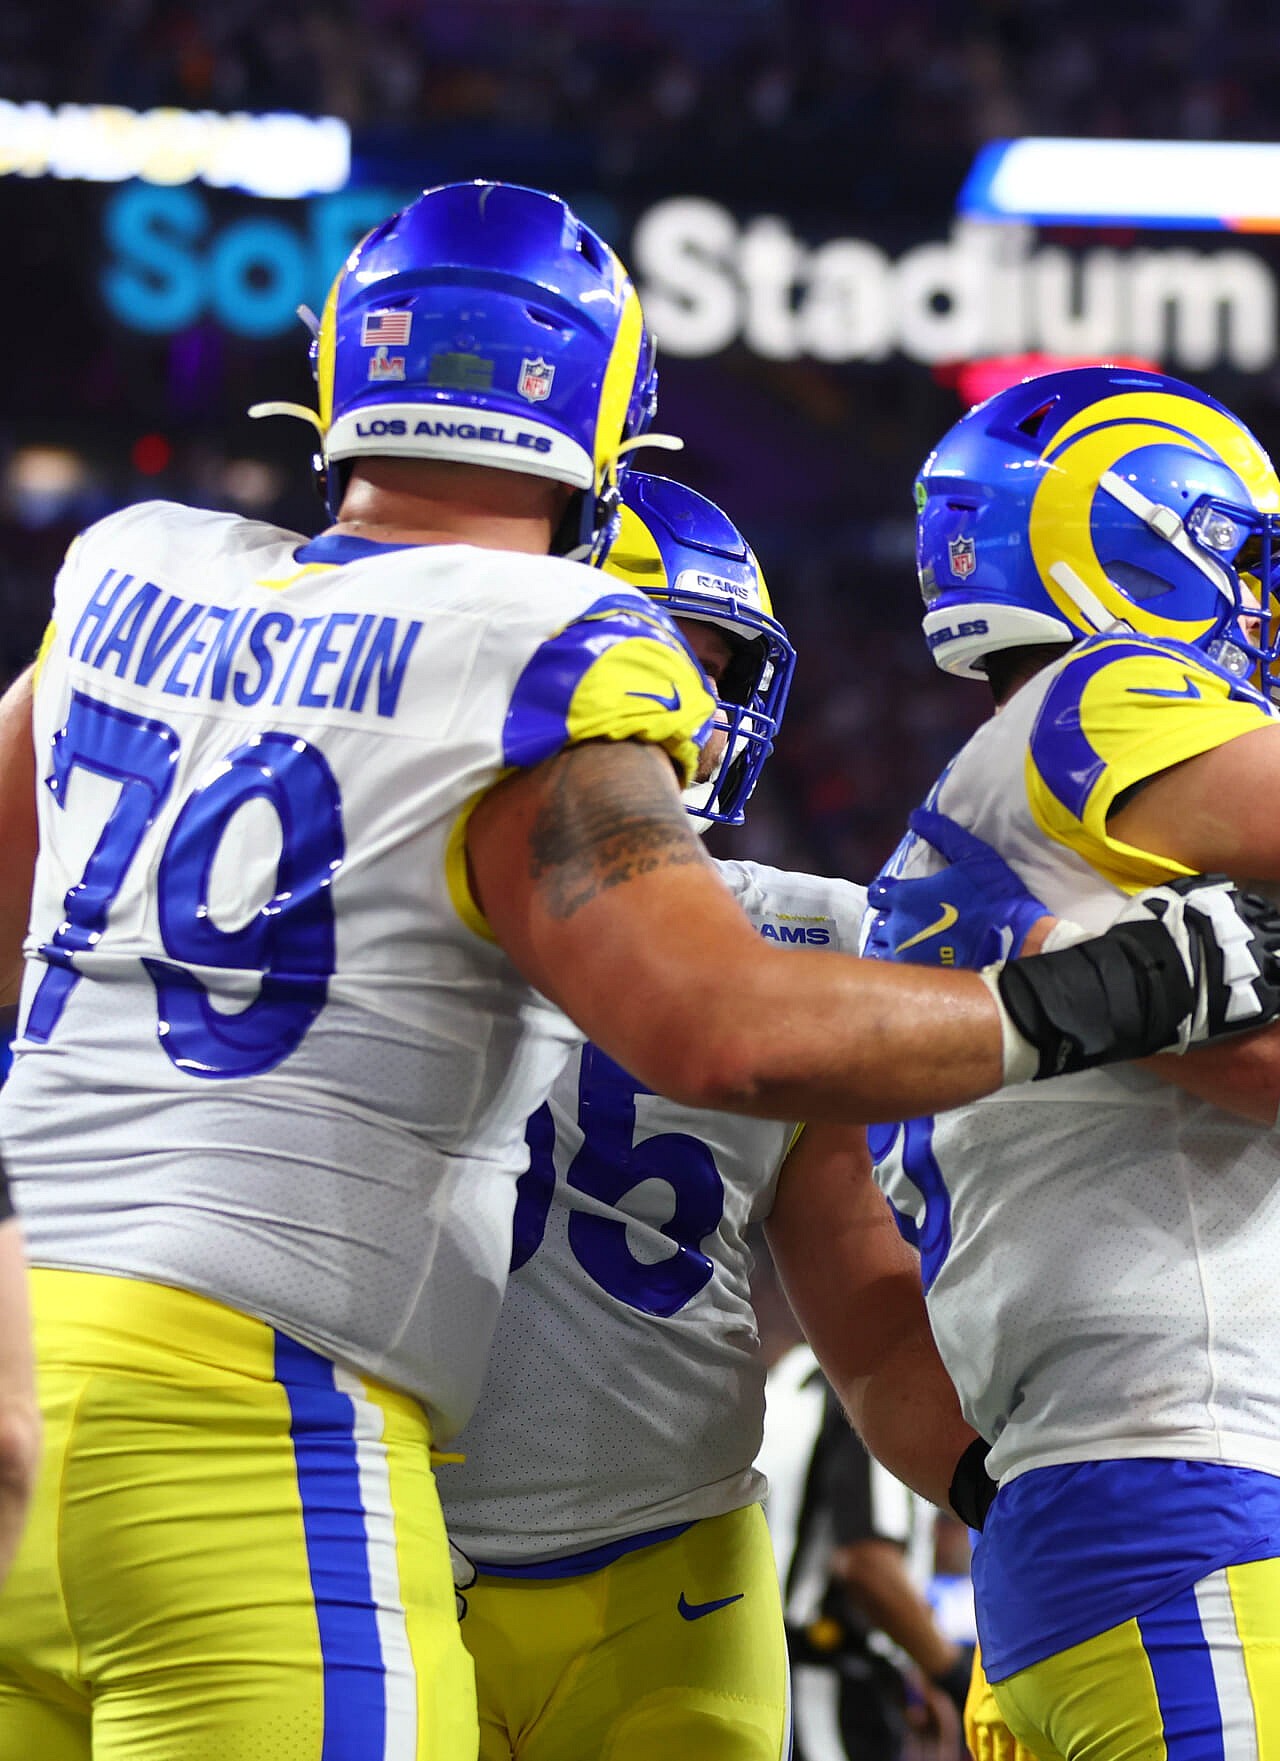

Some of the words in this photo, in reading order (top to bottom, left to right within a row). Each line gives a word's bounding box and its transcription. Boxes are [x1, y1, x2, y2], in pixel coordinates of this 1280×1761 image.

[632, 196, 1278, 372] Stadium
[356, 420, 407, 436] LOS
[414, 421, 553, 453] ANGELES
[697, 575, 749, 600] RAMS
[69, 568, 424, 718] HAVENSTEIN
[22, 687, 347, 1080] 79
[751, 923, 831, 946] AMS
